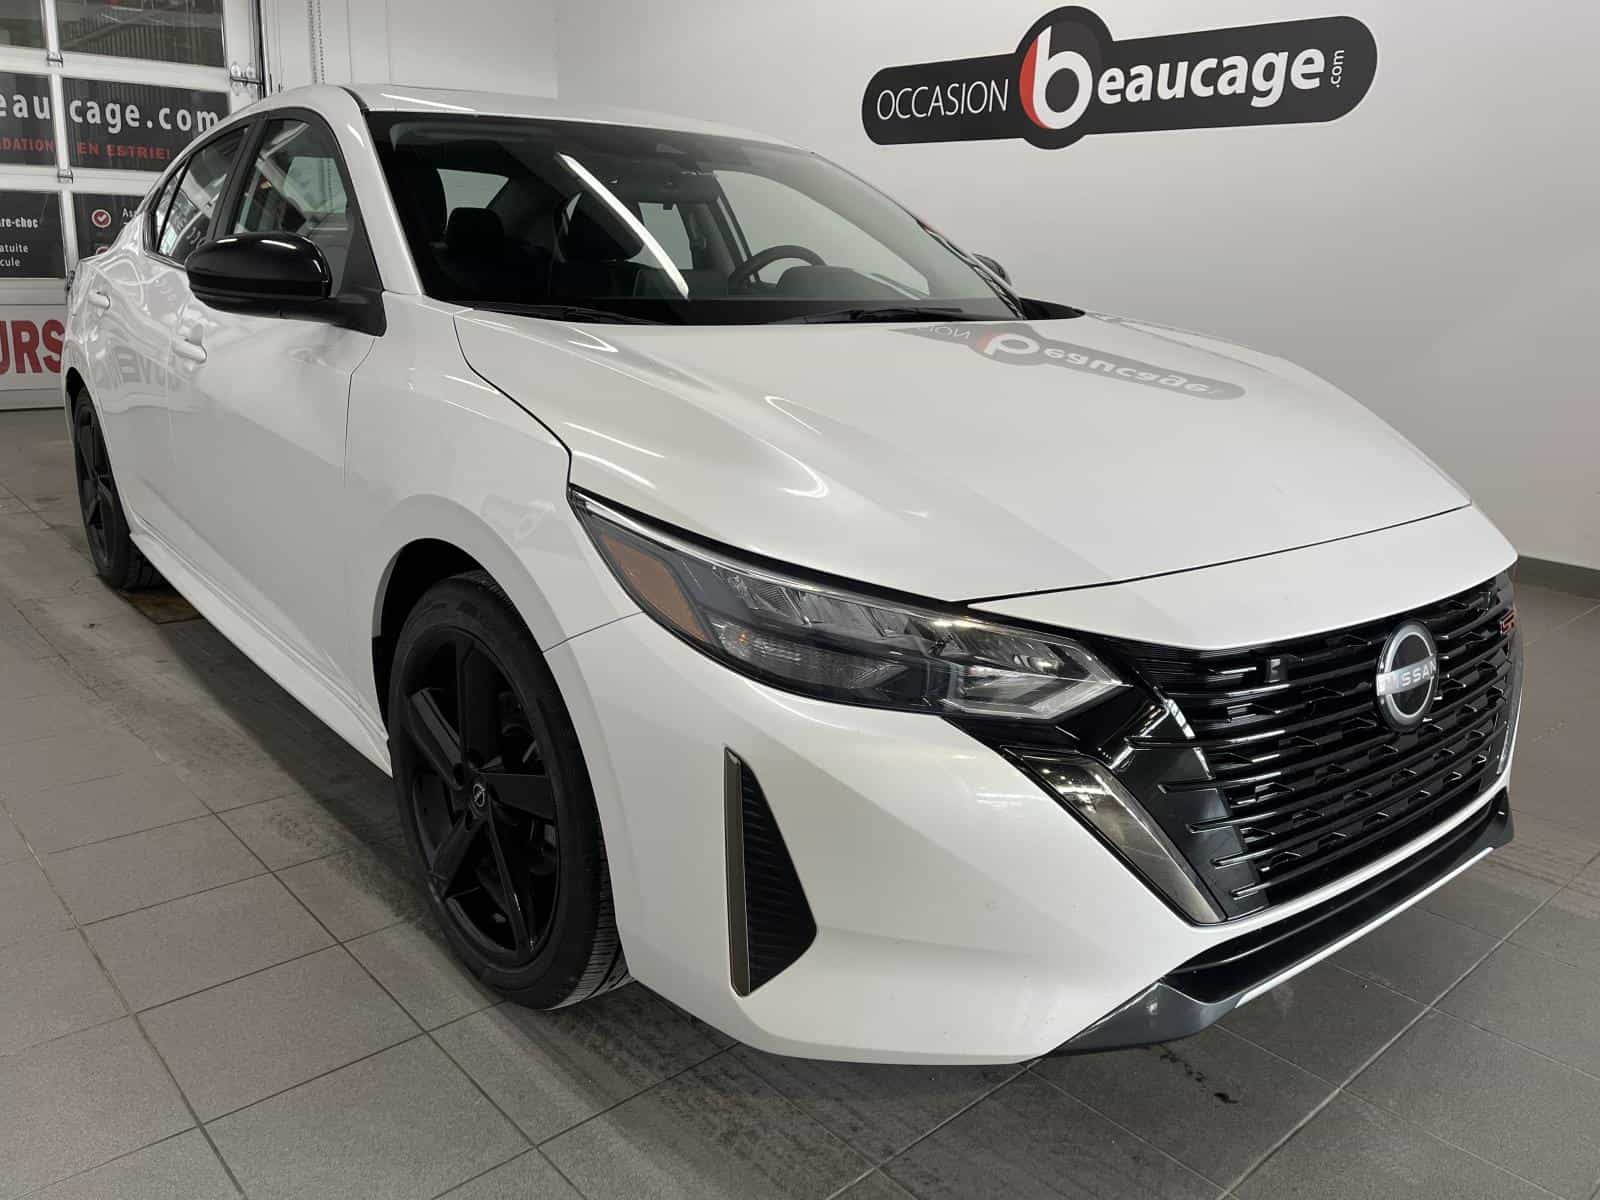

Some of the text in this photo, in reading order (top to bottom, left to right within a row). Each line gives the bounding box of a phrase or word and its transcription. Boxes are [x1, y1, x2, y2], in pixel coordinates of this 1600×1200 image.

[877, 25, 1345, 130] OCCASION beaucage .com
[0, 137, 55, 152] DATION
[77, 142, 99, 156] EN
[0, 216, 39, 229] re-choc
